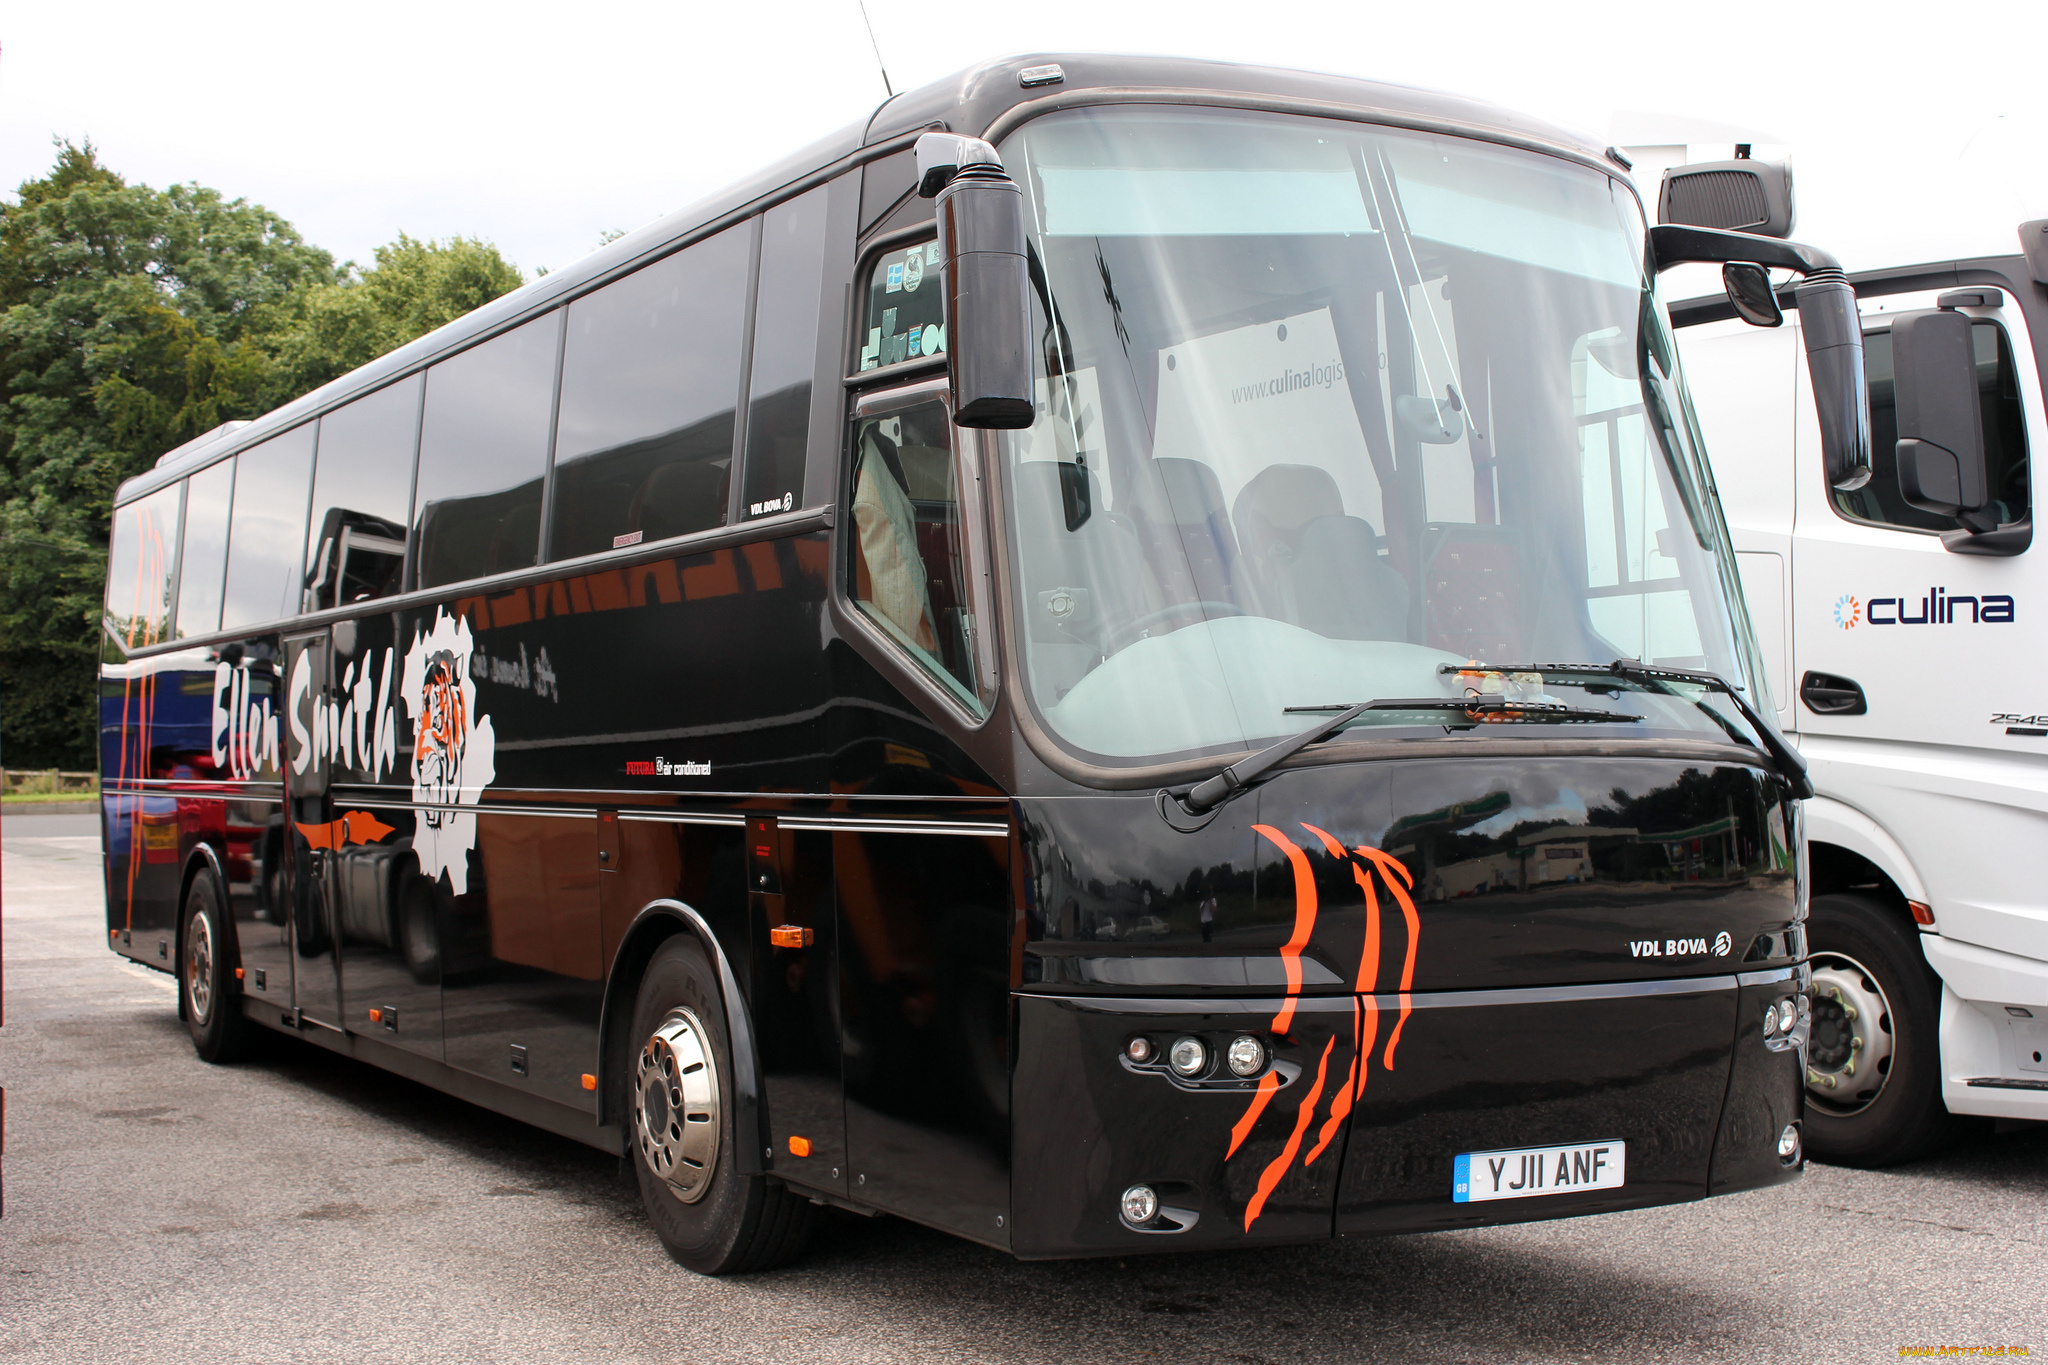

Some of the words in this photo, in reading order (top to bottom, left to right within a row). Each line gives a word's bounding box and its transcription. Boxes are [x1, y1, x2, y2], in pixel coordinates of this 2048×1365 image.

[750, 502, 763, 516] VDL
[763, 498, 781, 513] BOVA
[1866, 586, 2015, 625] culina
[212, 661, 280, 781] Ellen
[289, 647, 396, 784] Smith
[626, 761, 655, 775] FUTURA
[663, 761, 673, 775] air
[673, 760, 711, 775] conditioned
[1629, 940, 1662, 957] VDL
[1665, 938, 1708, 956] BOVA
[1554, 1147, 1610, 1187] ANF
[1456, 1183, 1468, 1194] GB
